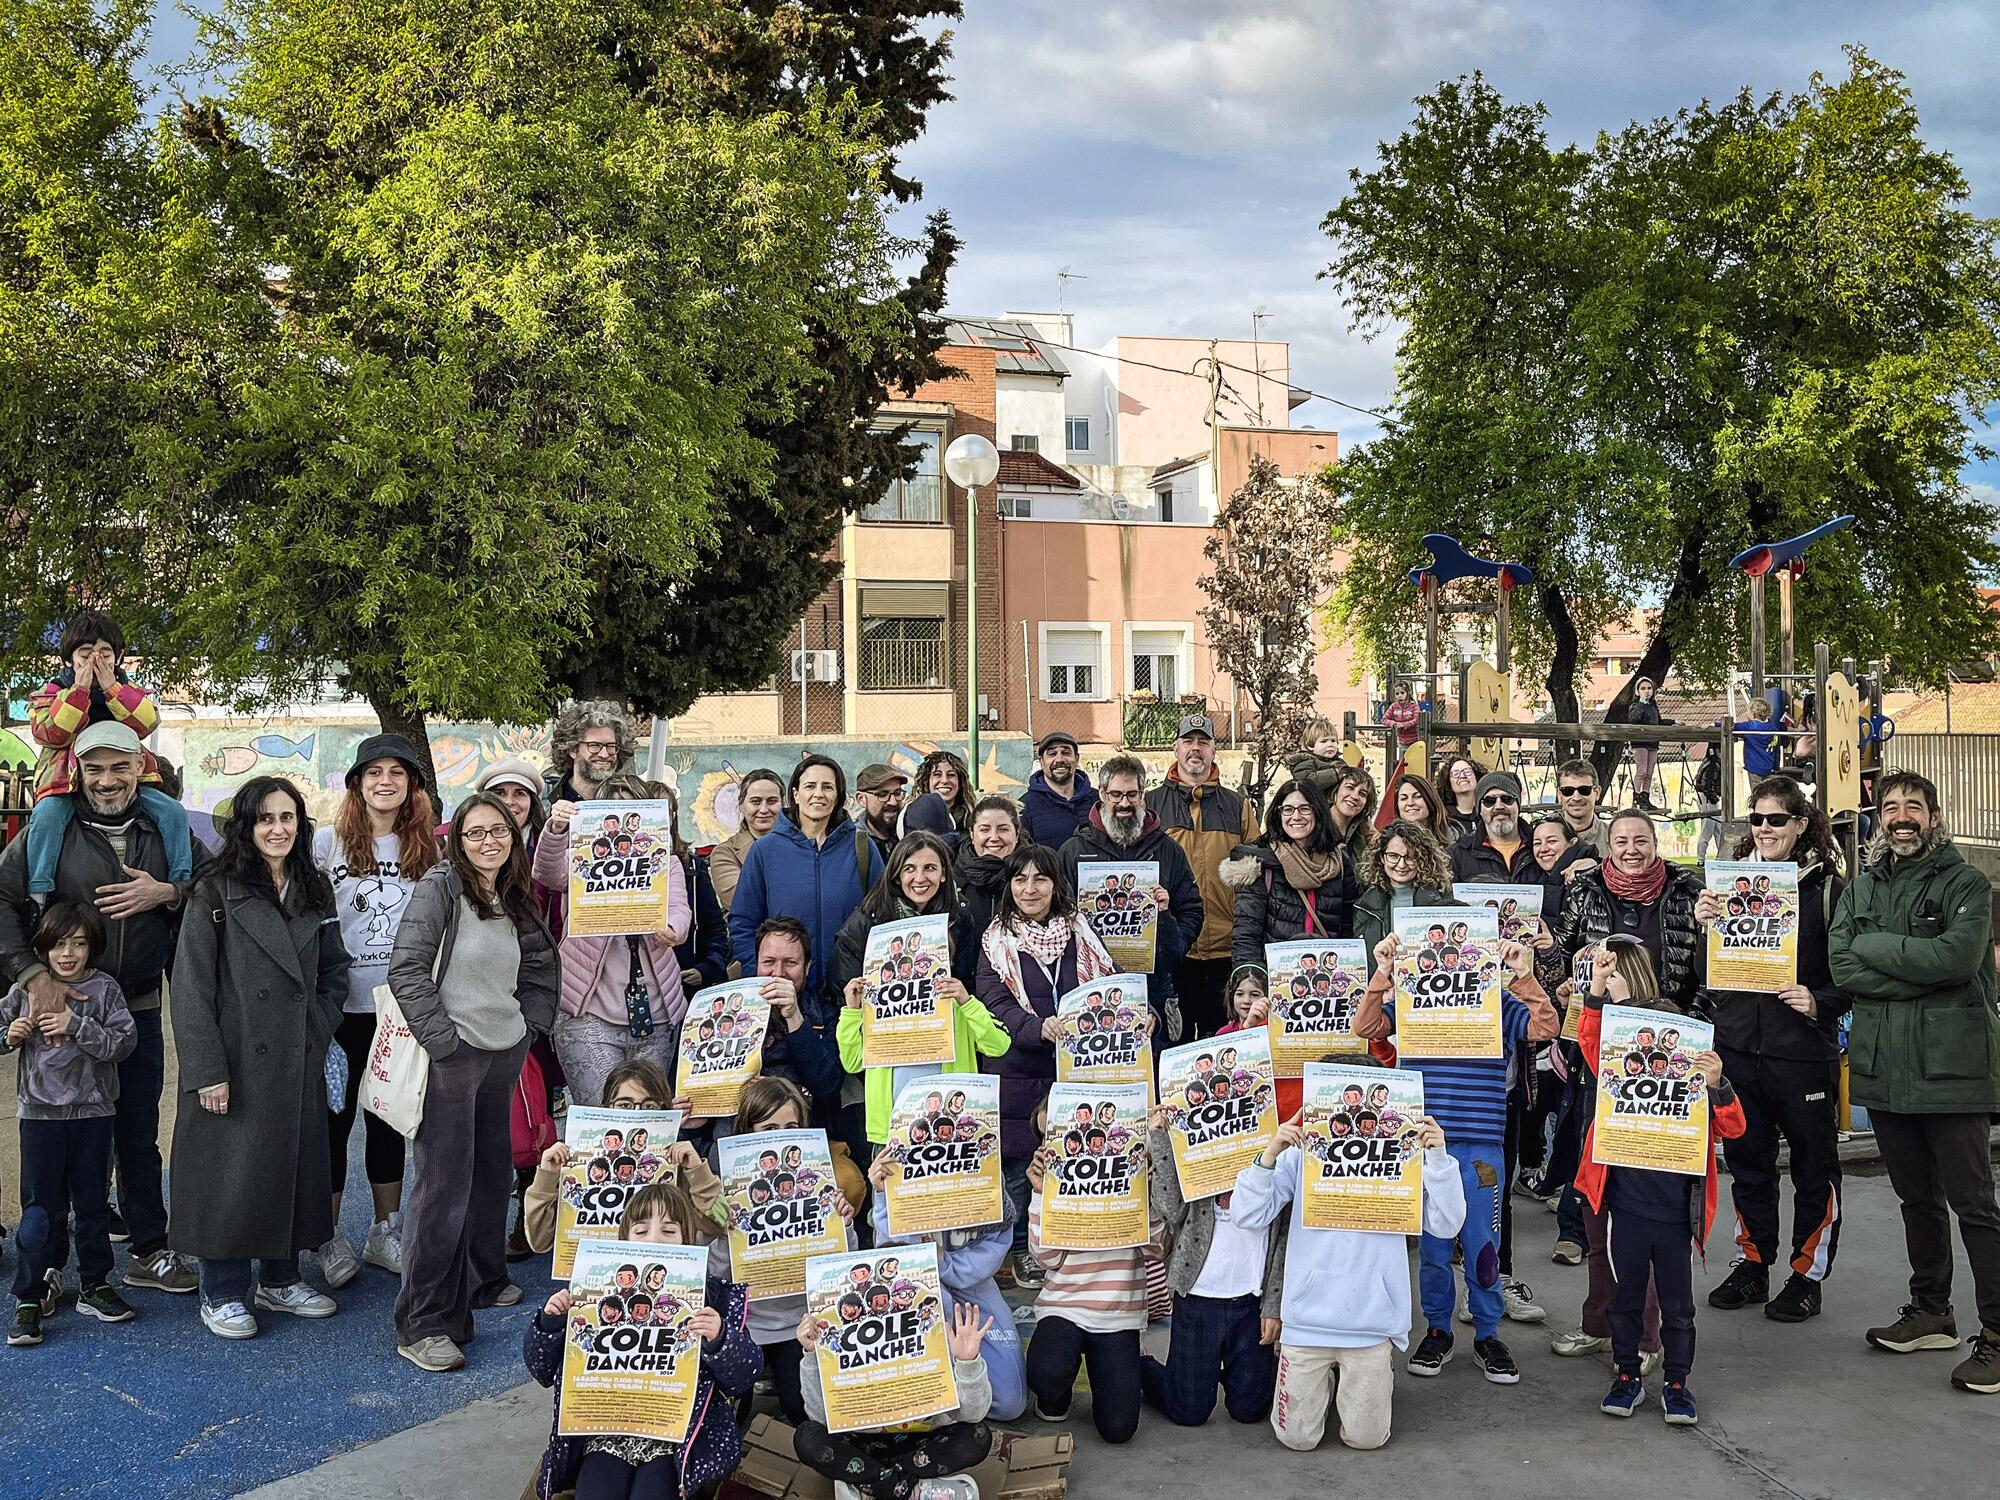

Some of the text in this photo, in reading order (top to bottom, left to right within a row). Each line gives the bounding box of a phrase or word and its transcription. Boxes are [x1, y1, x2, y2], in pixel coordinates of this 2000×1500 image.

[588, 857, 651, 880] COLE
[585, 875, 651, 892] BANCHEL
[1092, 910, 1142, 927] COLE
[1725, 918, 1781, 936] COLE
[1098, 925, 1143, 936] ANCHEL
[1722, 936, 1780, 947] BANCHEL
[360, 952, 378, 961] York
[876, 978, 932, 1005] COLE
[1415, 971, 1480, 995] COLE
[875, 998, 934, 1019] BANCHEL
[1288, 997, 1349, 1020] COLE
[1412, 992, 1482, 1008] BANCHEL
[1284, 1018, 1350, 1033] BANCHEL
[695, 1037, 749, 1062] COLE
[1075, 1031, 1134, 1054] COLE
[690, 1055, 746, 1074] BANCHEL
[1073, 1050, 1136, 1067] BANCHEL
[1619, 1078, 1689, 1102] COLE
[1805, 1092, 1826, 1102] PUMA
[1186, 1096, 1255, 1130] COLE
[1614, 1100, 1689, 1116] BANCHEL
[1187, 1115, 1258, 1146] BANCHEL
[906, 1142, 978, 1164] COLE
[1326, 1139, 1400, 1162] COLE
[903, 1158, 980, 1179] BANCHEL
[1062, 1155, 1128, 1181] COLE
[1322, 1162, 1401, 1177] BANCHEL
[1058, 1177, 1130, 1195] BANCHEL
[749, 1197, 820, 1230] COLE
[748, 1218, 824, 1246] BANCHEL
[592, 1327, 676, 1354] COLE
[839, 1310, 919, 1351] COLE
[586, 1354, 675, 1370] BANCHEL
[839, 1335, 924, 1369] BANCHEL
